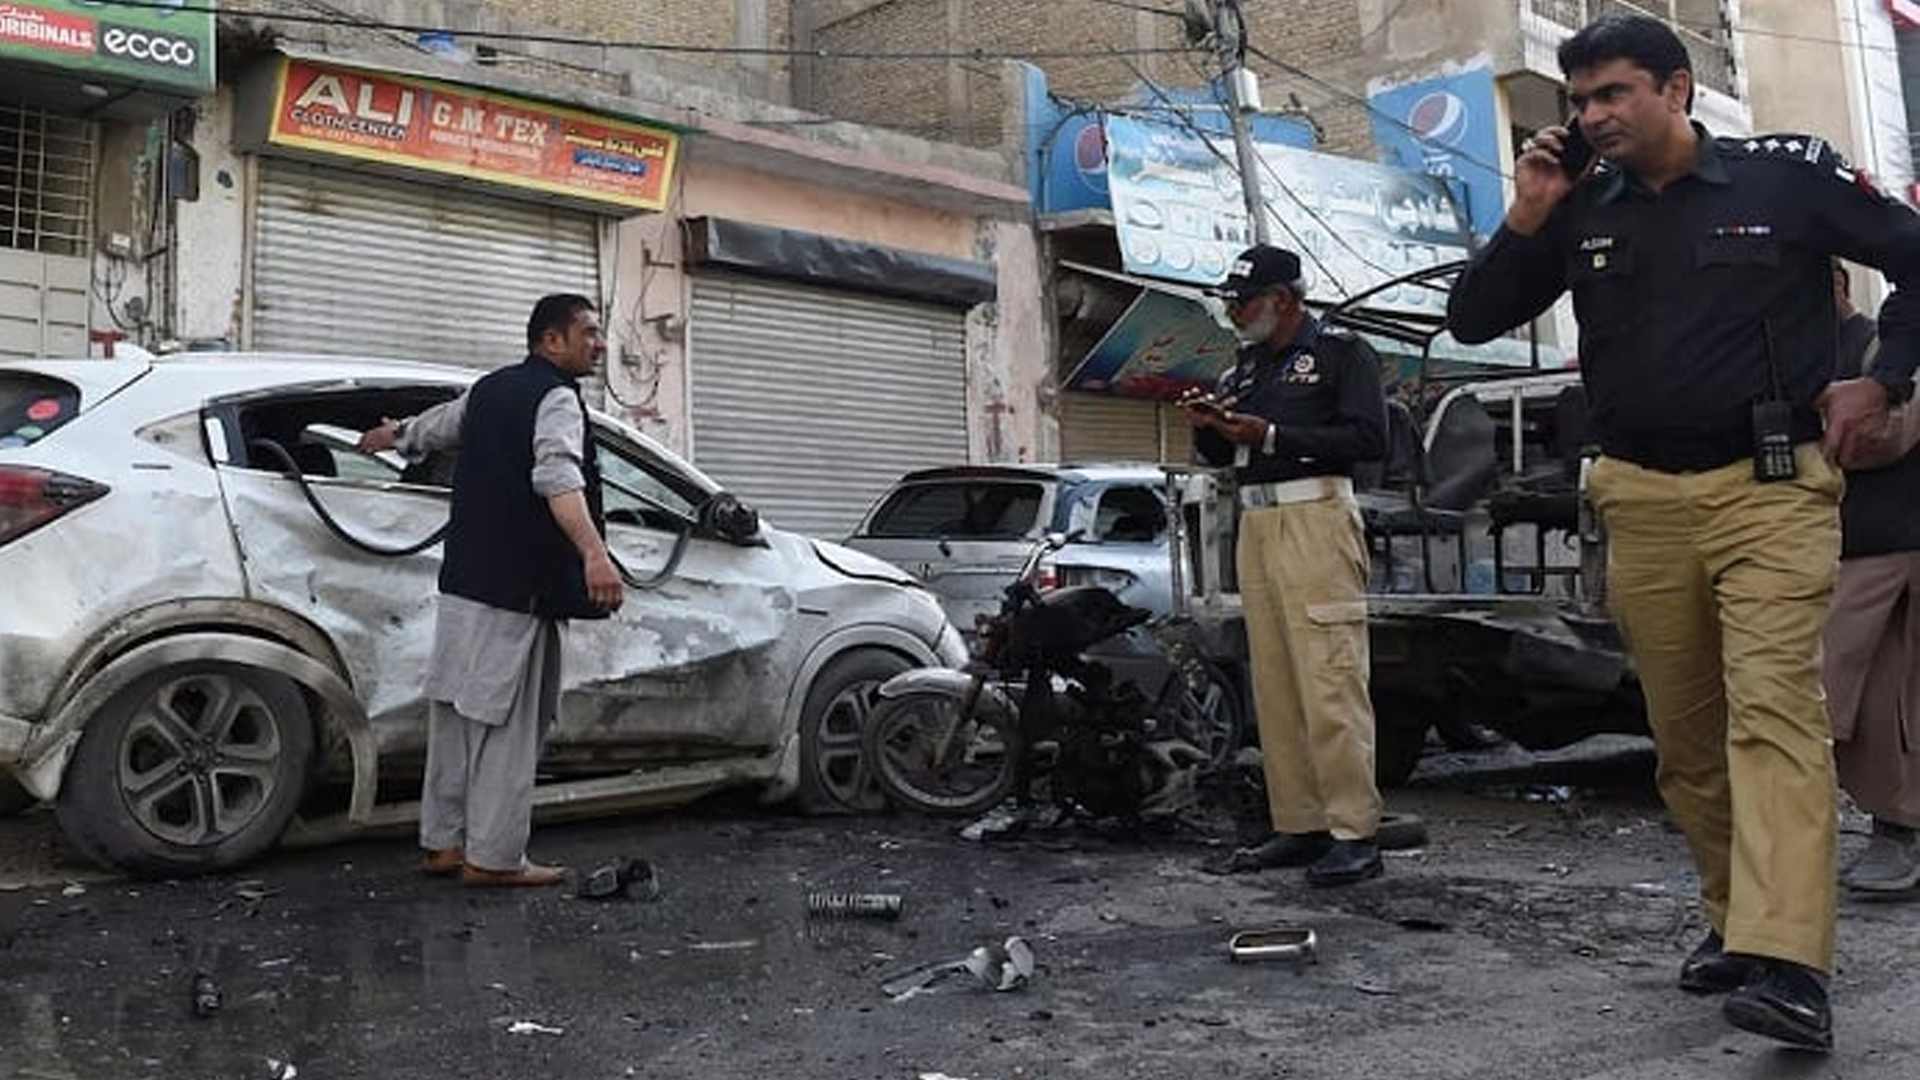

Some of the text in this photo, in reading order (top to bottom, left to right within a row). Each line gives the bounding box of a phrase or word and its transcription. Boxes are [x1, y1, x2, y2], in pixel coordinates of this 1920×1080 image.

[103, 28, 195, 66] ecco
[295, 74, 415, 126] ALI
[290, 109, 344, 131] CLOTH
[494, 113, 549, 147] TEX
